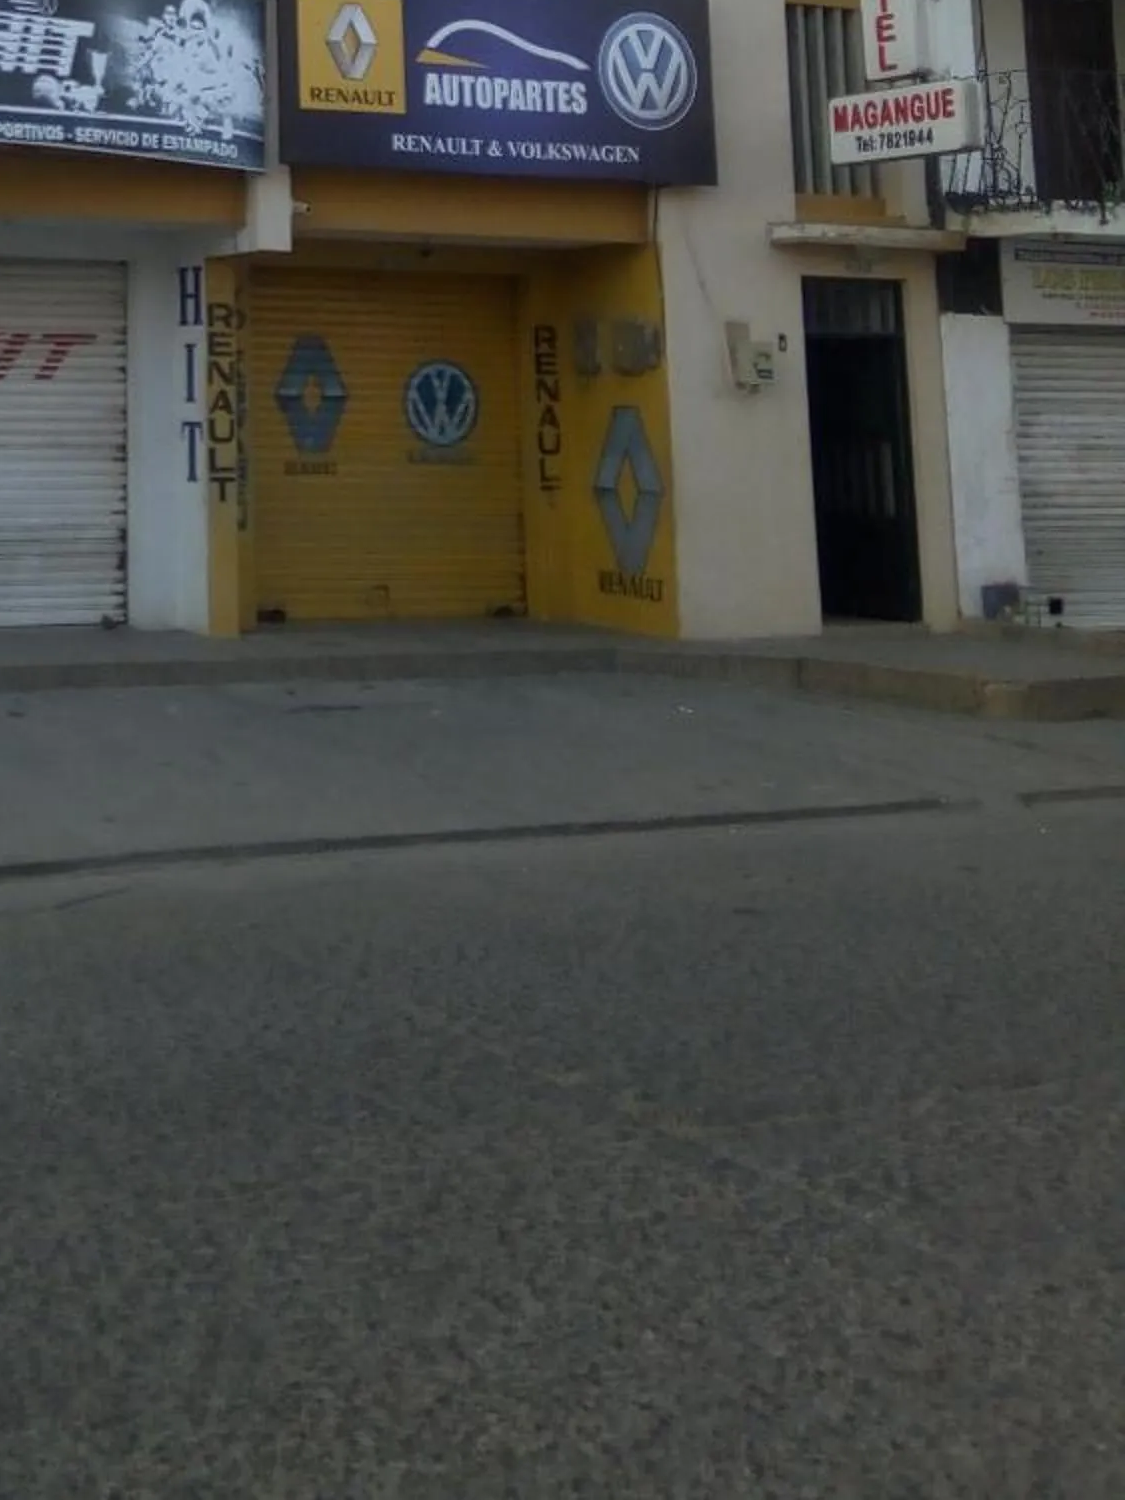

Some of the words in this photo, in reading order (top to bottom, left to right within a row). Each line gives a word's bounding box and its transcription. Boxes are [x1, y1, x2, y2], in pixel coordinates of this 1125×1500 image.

[310, 87, 396, 107] RENAULT
[424, 72, 588, 115] AUTOPARTES
[834, 88, 955, 132] MAGANGUE
[75, 126, 139, 148] SERVICIO
[142, 132, 160, 149] DE
[163, 135, 238, 159] ESTAMPADO
[391, 133, 484, 157] RENAULT
[488, 140, 503, 158] &
[508, 141, 641, 163] VOLKSWAGEN
[179, 266, 203, 483] HIT
[207, 303, 236, 502] RENAULT
